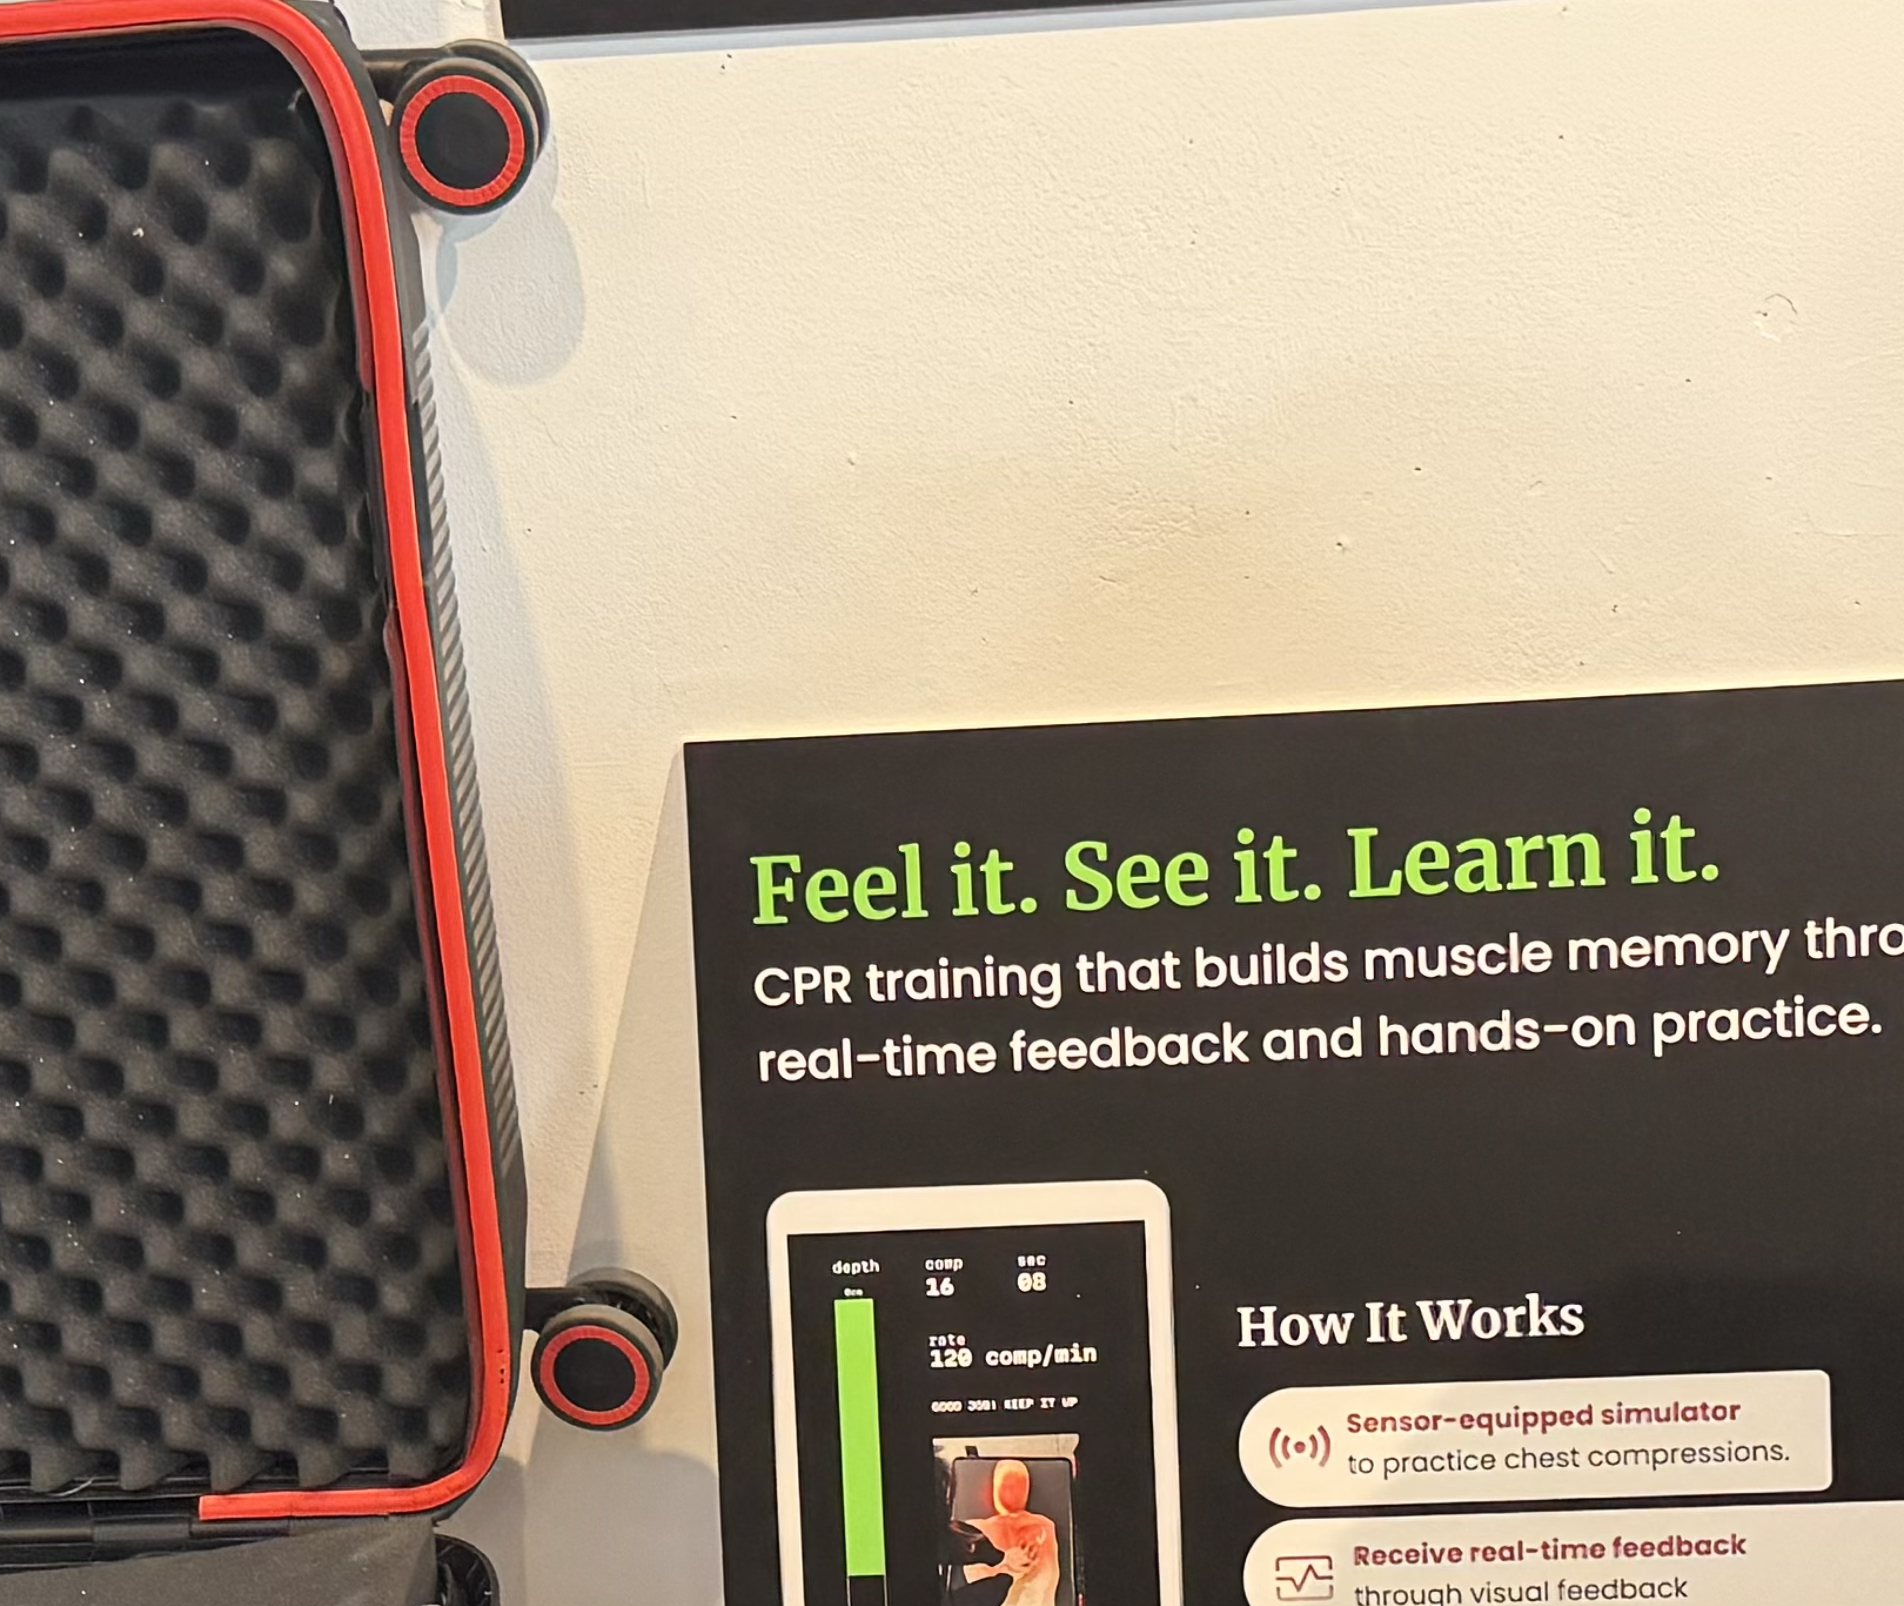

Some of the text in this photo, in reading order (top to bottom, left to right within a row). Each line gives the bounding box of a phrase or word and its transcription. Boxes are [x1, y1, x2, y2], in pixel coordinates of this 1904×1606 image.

[750, 808, 1718, 924] Feel it. See it. Learn it.
[755, 965, 851, 1006] CPR
[866, 955, 1061, 1008] training
[1076, 951, 1181, 992] that
[1196, 942, 1348, 987] builds
[1365, 932, 1552, 980] muscle
[1569, 929, 1790, 974] memory
[760, 995, 1881, 1081] real-time feedback and hands-on practice.
[832, 1259, 879, 1274] depth
[926, 1259, 963, 1271] comp
[1018, 1255, 1046, 1267] sec
[926, 1277, 954, 1296] 16
[1018, 1272, 1046, 1292] 08
[1237, 1293, 1584, 1347] How It Works
[930, 1334, 965, 1346] rate
[931, 1343, 1097, 1368] 120 comp/min
[1346, 1400, 1739, 1436] Sensor-equipped simulator
[1348, 1441, 1789, 1480] to practice chest compressions.
[1353, 1534, 1747, 1566] Receive real-time feedback
[1470, 1581, 1548, 1603] visual
[1558, 1577, 1687, 1600] feedback
